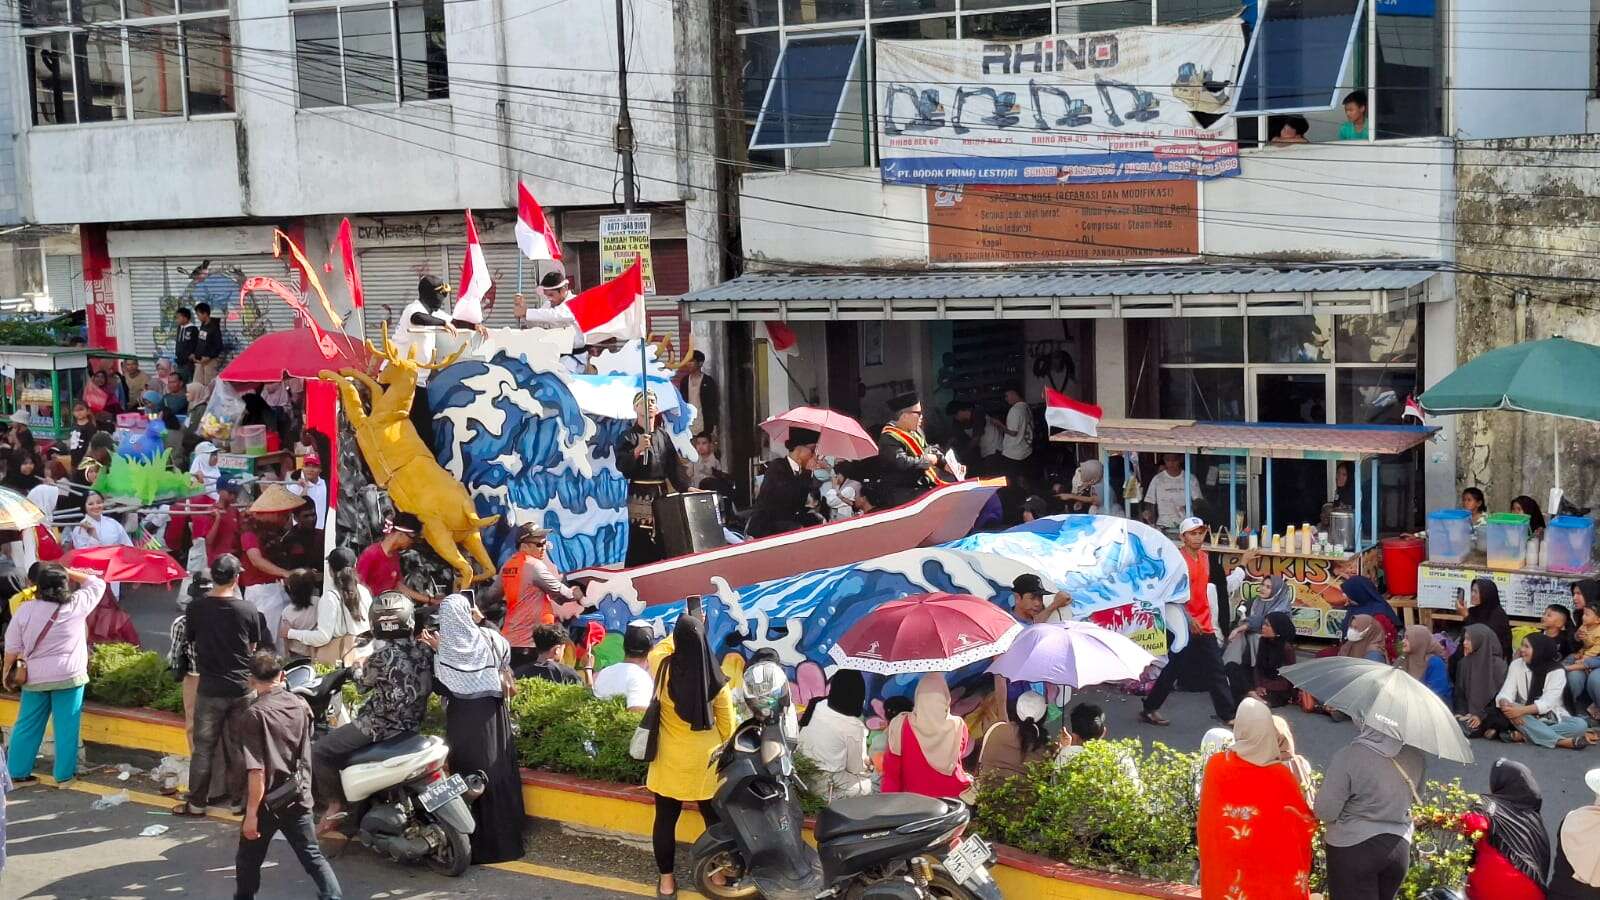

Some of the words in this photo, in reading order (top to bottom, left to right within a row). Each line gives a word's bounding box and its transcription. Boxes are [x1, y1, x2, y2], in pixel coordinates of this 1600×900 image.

[913, 168, 943, 178] BADAK
[945, 168, 976, 178] PRIMA
[978, 168, 1018, 178] LESTARI
[1101, 190, 1119, 200] DAN
[629, 235, 649, 243] TINGGI
[603, 243, 627, 251] BADAN
